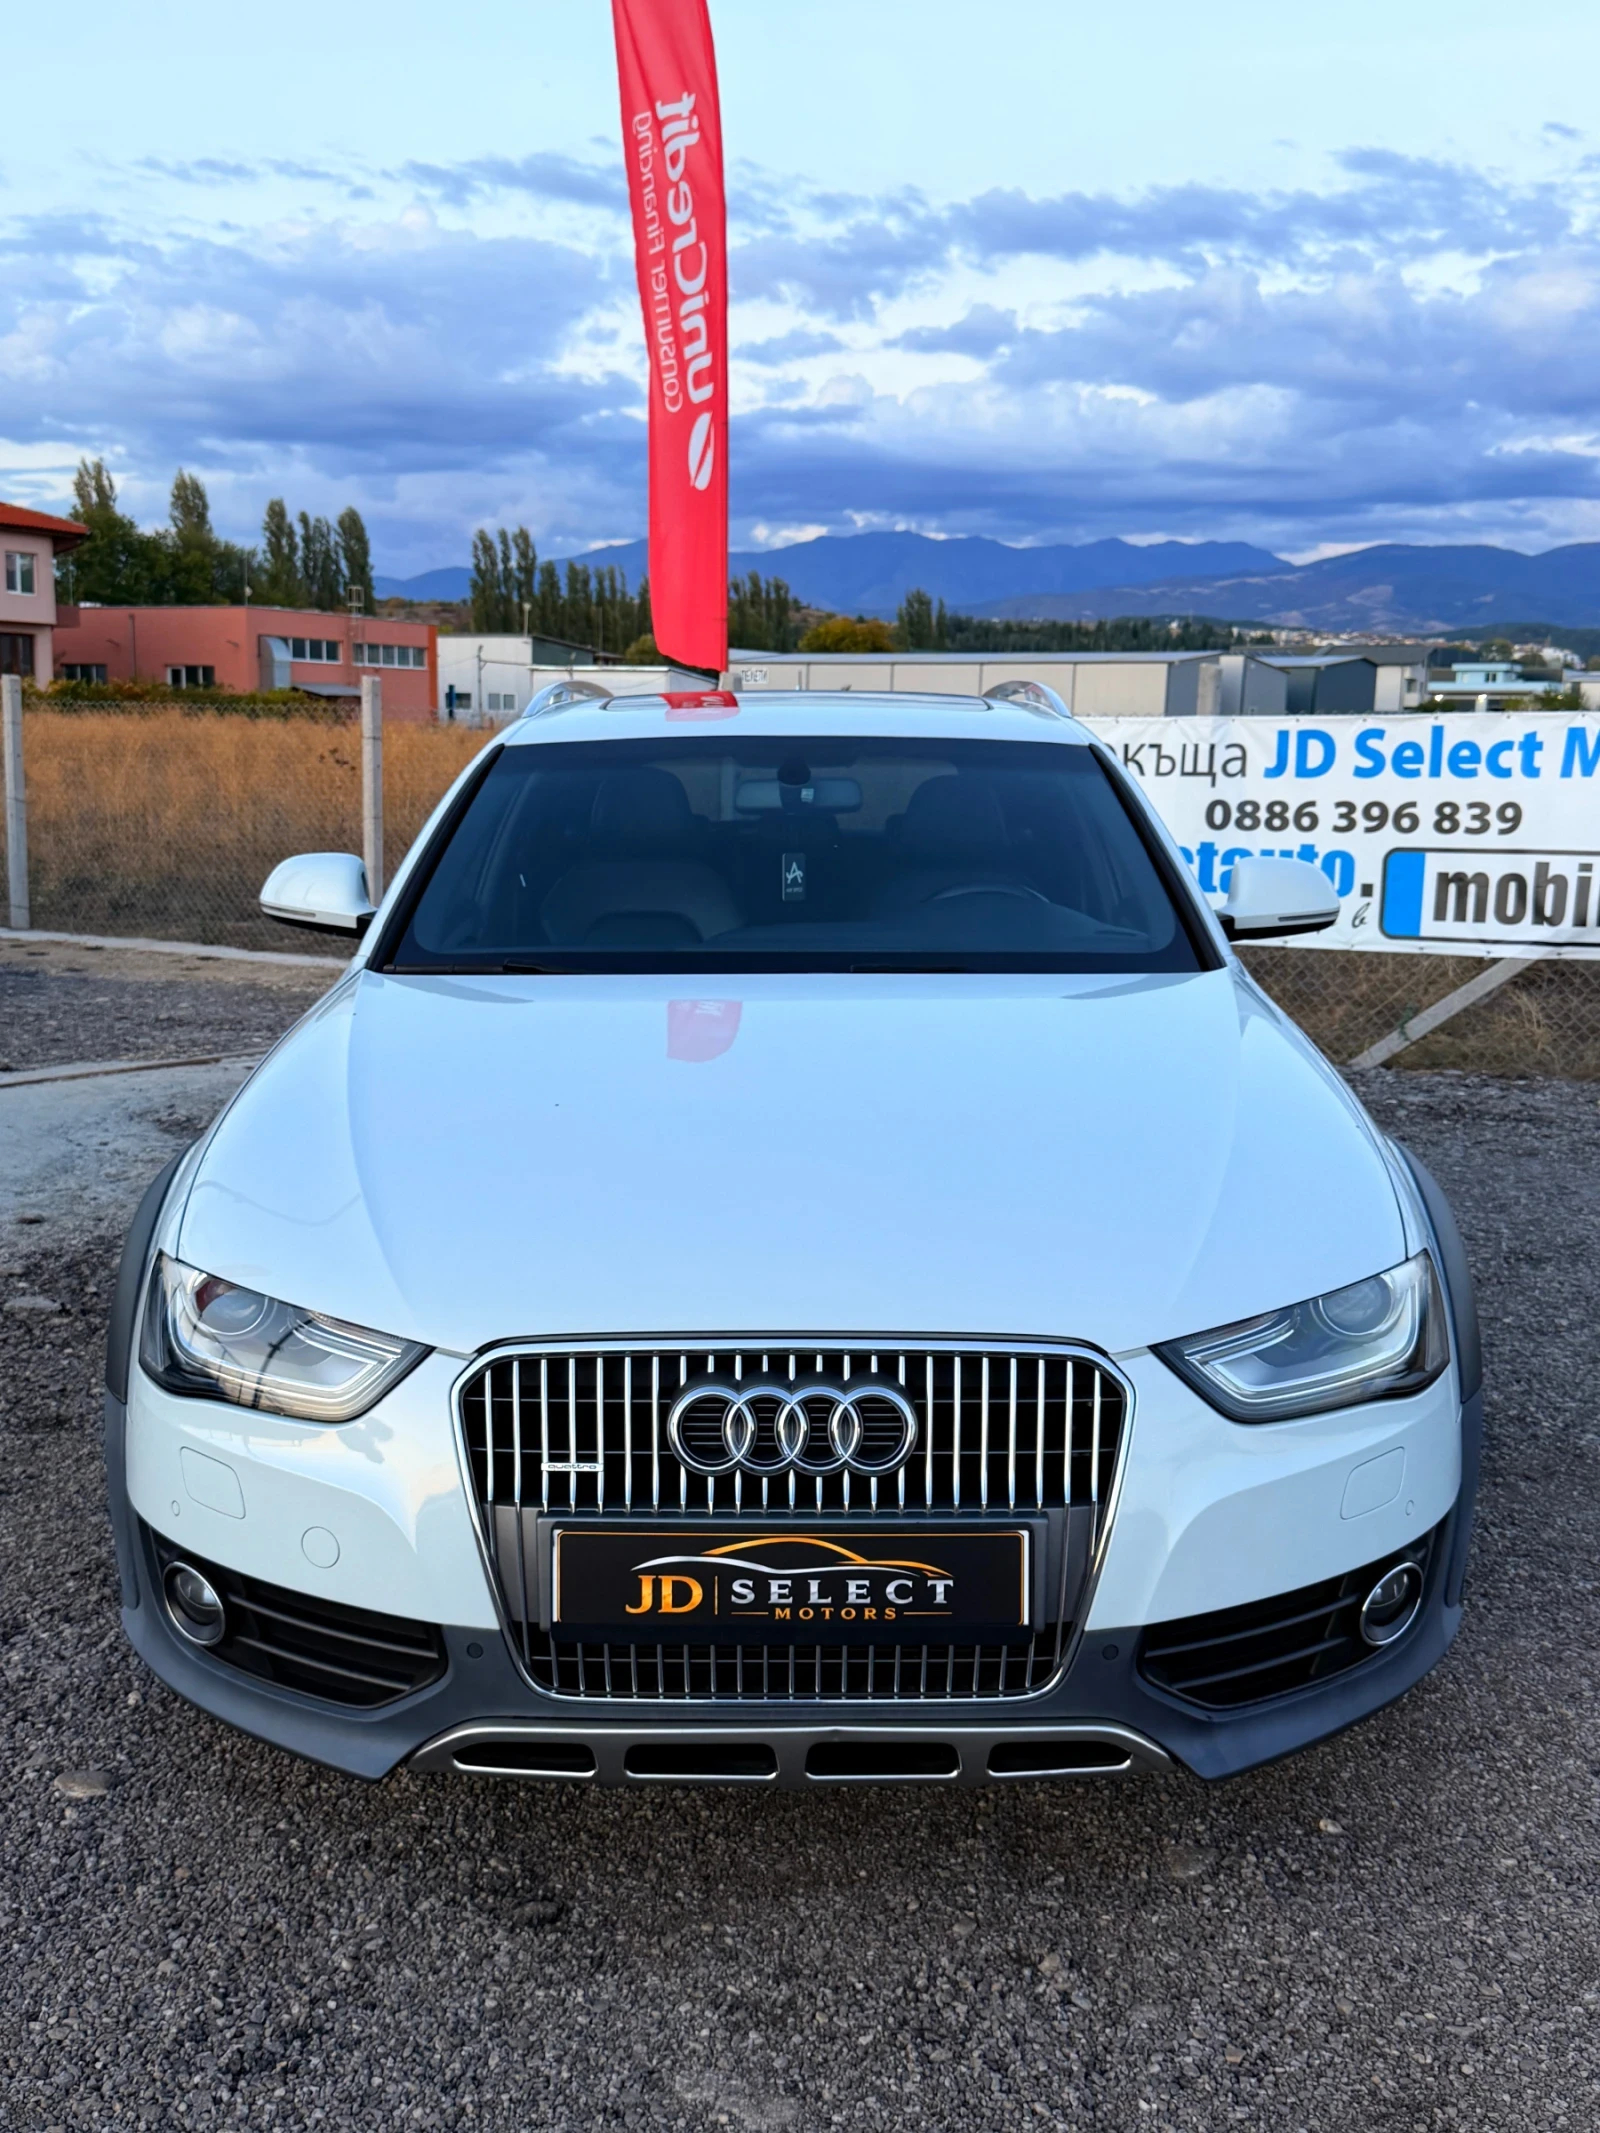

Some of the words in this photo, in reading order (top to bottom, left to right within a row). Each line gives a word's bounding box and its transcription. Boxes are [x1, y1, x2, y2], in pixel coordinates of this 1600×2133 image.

[1104, 743, 1247, 788] къща
[1263, 729, 1336, 779] JD
[1352, 725, 1544, 779] Select
[1205, 798, 1319, 832] 0886
[1332, 801, 1420, 833] 396
[1433, 801, 1523, 835] 839
[1433, 862, 1600, 927] mobi
[547, 1463, 598, 1471] quattro
[625, 1575, 703, 1614] JD
[731, 1578, 954, 1604] SELECT
[774, 1607, 897, 1620] MOTORS
